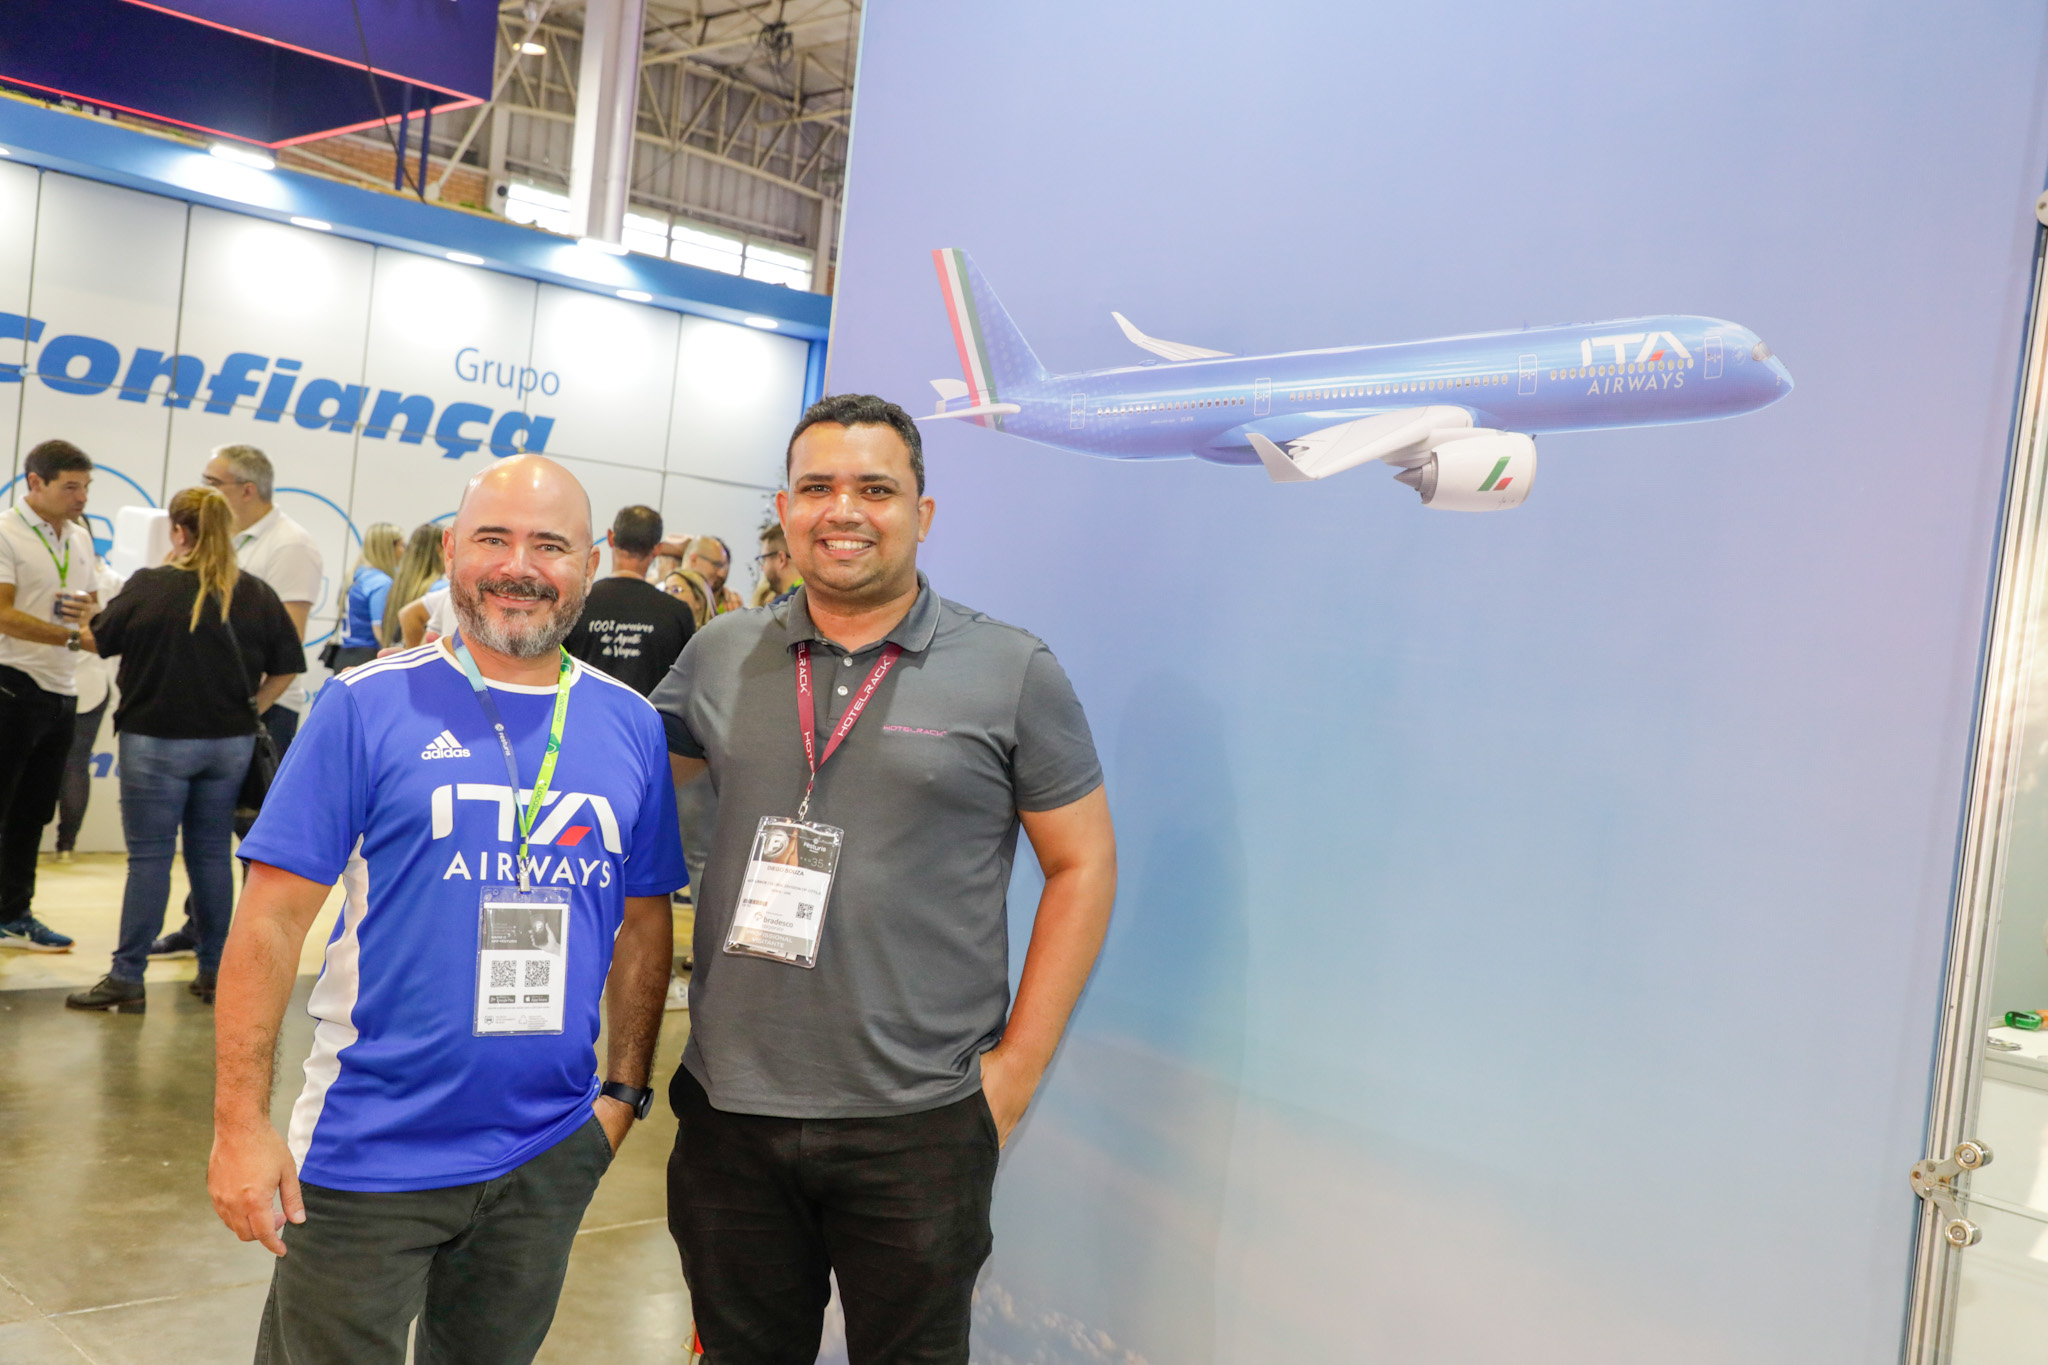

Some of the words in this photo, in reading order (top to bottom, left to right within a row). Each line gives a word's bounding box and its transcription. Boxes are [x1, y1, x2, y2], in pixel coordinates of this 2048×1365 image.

[1581, 331, 1692, 367] ITA
[455, 347, 560, 400] Grupo
[1586, 372, 1684, 395] AIRWAYS
[798, 642, 808, 693] ELRACK
[837, 659, 891, 737] HOTELRACK
[421, 748, 471, 760] adidas
[431, 783, 622, 854] ITA
[443, 851, 611, 888] AIRWAYS
[763, 917, 793, 928] bradesco
